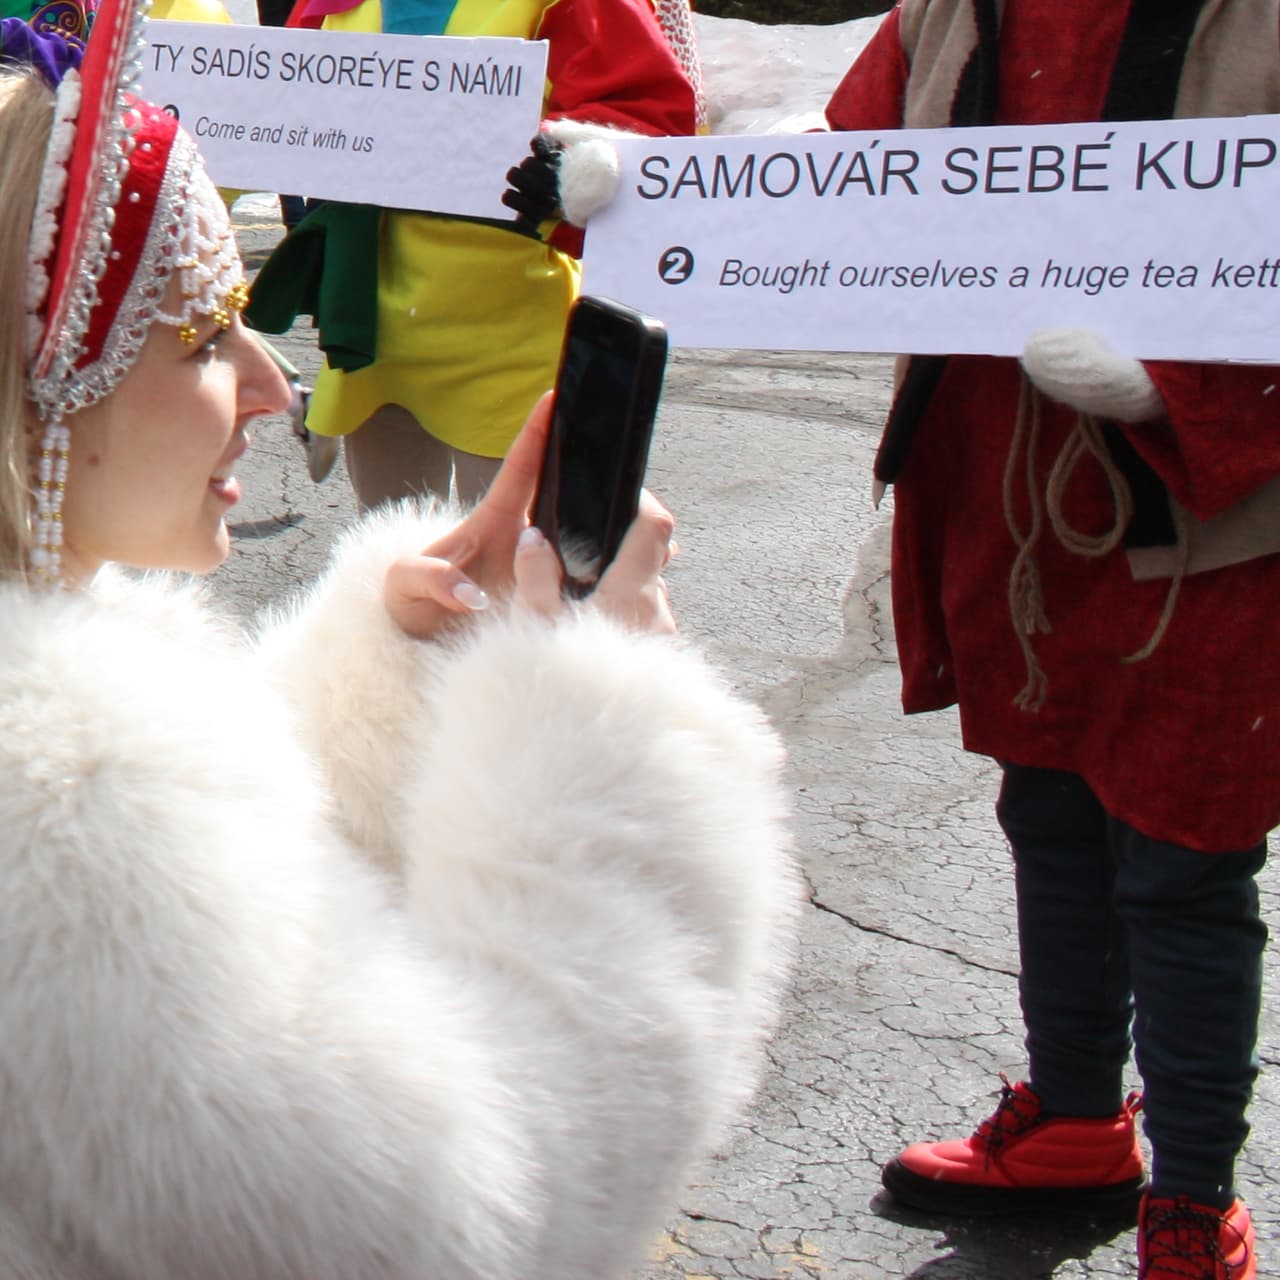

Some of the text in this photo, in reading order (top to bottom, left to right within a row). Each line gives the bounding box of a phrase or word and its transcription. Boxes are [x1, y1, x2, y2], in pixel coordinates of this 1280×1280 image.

[151, 43, 522, 97] TY SADÍS SKORÉYE S NÁMI
[195, 116, 374, 153] Come and sit with us
[636, 132, 1277, 200] SAMOVÁR SEBÉ KUP
[660, 248, 1280, 297] 2 Bought ourselves a huge tea kett
